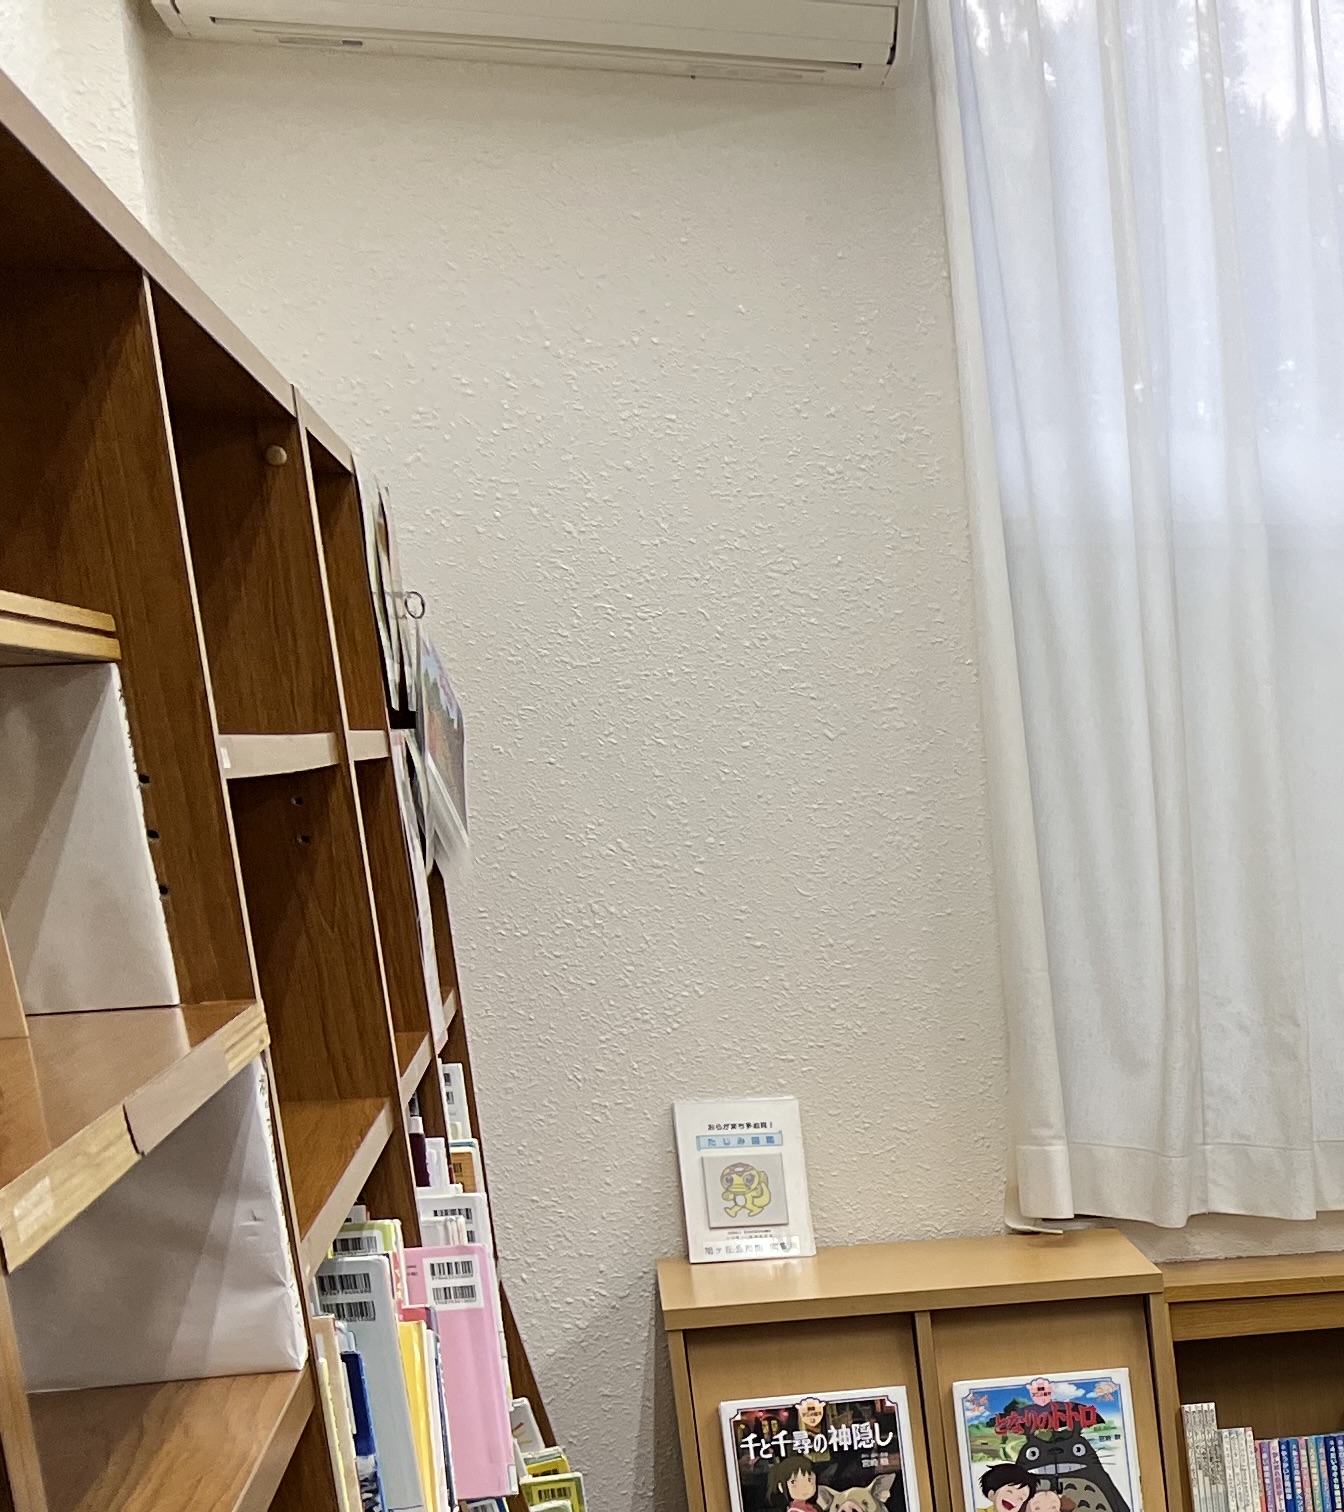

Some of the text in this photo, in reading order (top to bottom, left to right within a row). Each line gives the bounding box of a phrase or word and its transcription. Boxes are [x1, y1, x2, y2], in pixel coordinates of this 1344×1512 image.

[994, 1402, 1097, 1435] となりのトトロ
[740, 1421, 893, 1460] 千と千尋の神隠し
